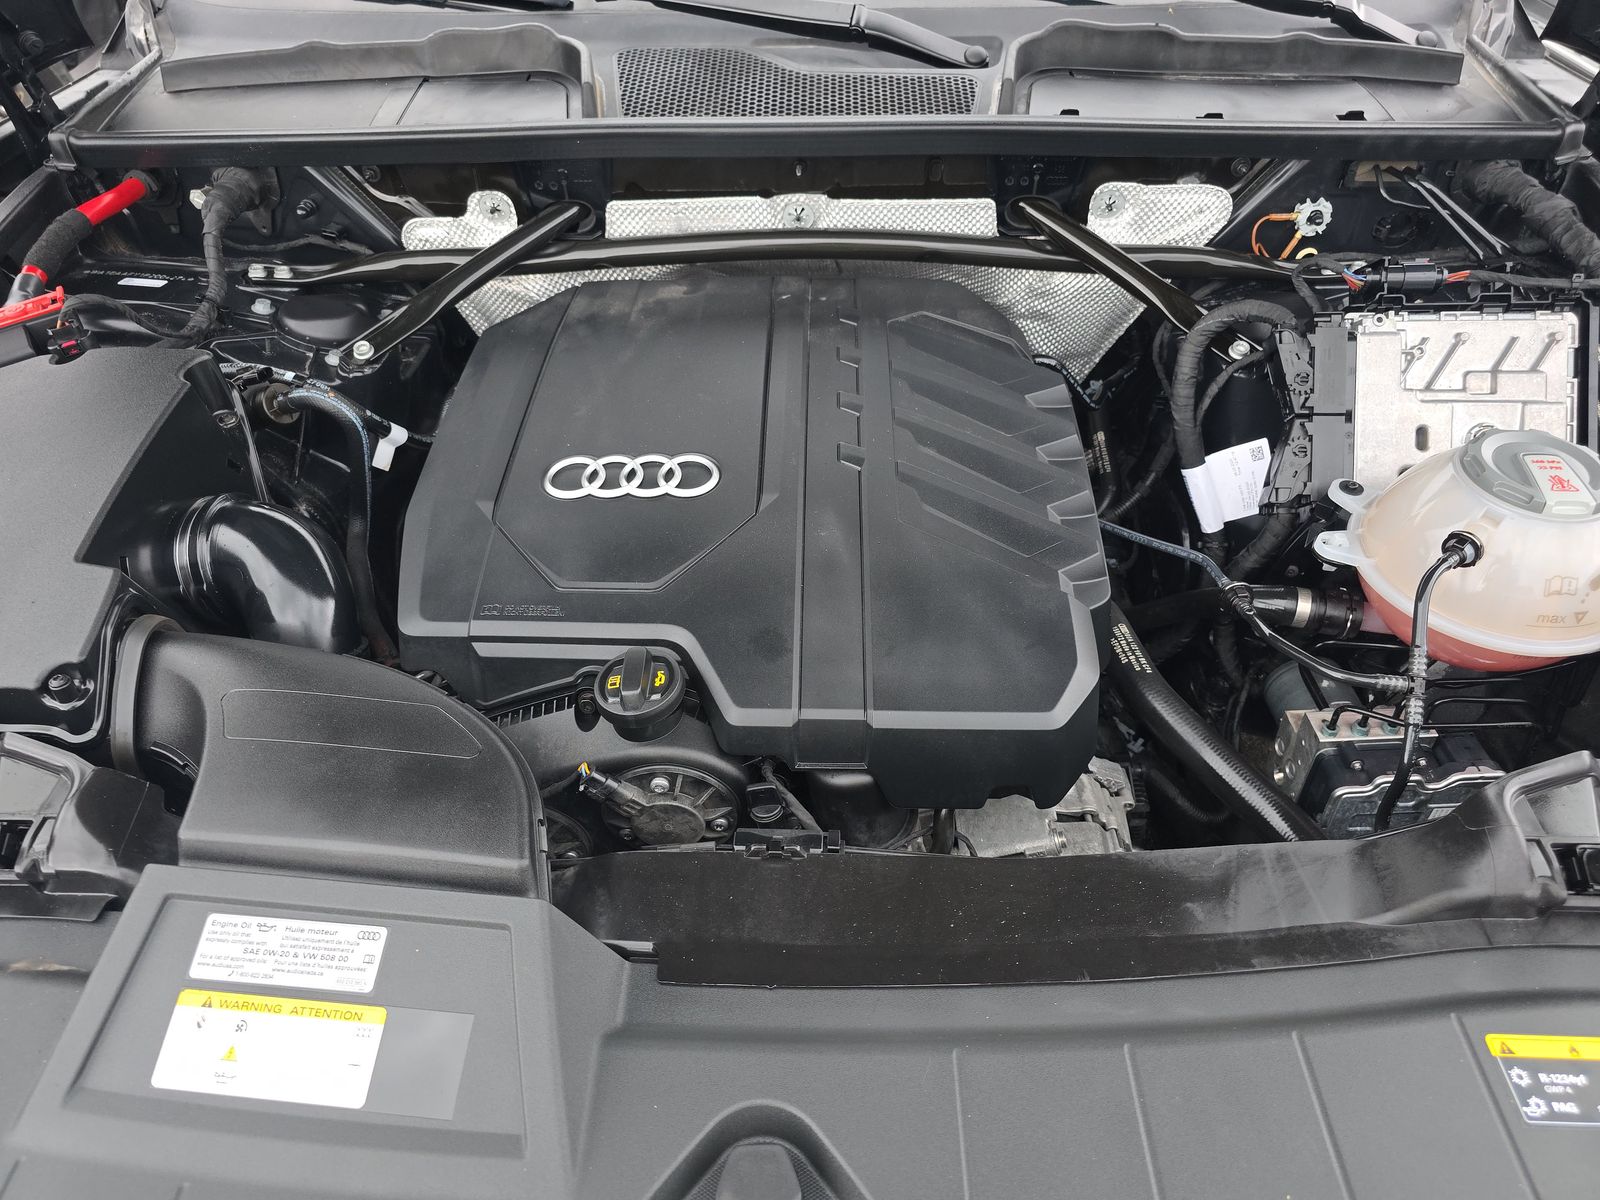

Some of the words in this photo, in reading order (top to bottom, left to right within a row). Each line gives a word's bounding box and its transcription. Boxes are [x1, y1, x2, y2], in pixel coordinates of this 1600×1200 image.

[1536, 615, 1567, 623] max
[211, 919, 238, 929] Engine
[240, 921, 252, 929] Oil
[284, 925, 305, 933] Huile
[307, 928, 338, 936] moteur
[242, 947, 261, 955] SAE
[262, 948, 290, 957] 0W-20
[320, 953, 336, 961] 508
[218, 998, 283, 1014] WARNING
[289, 1005, 364, 1022] ATTENTION
[1551, 1102, 1580, 1114] PAG
